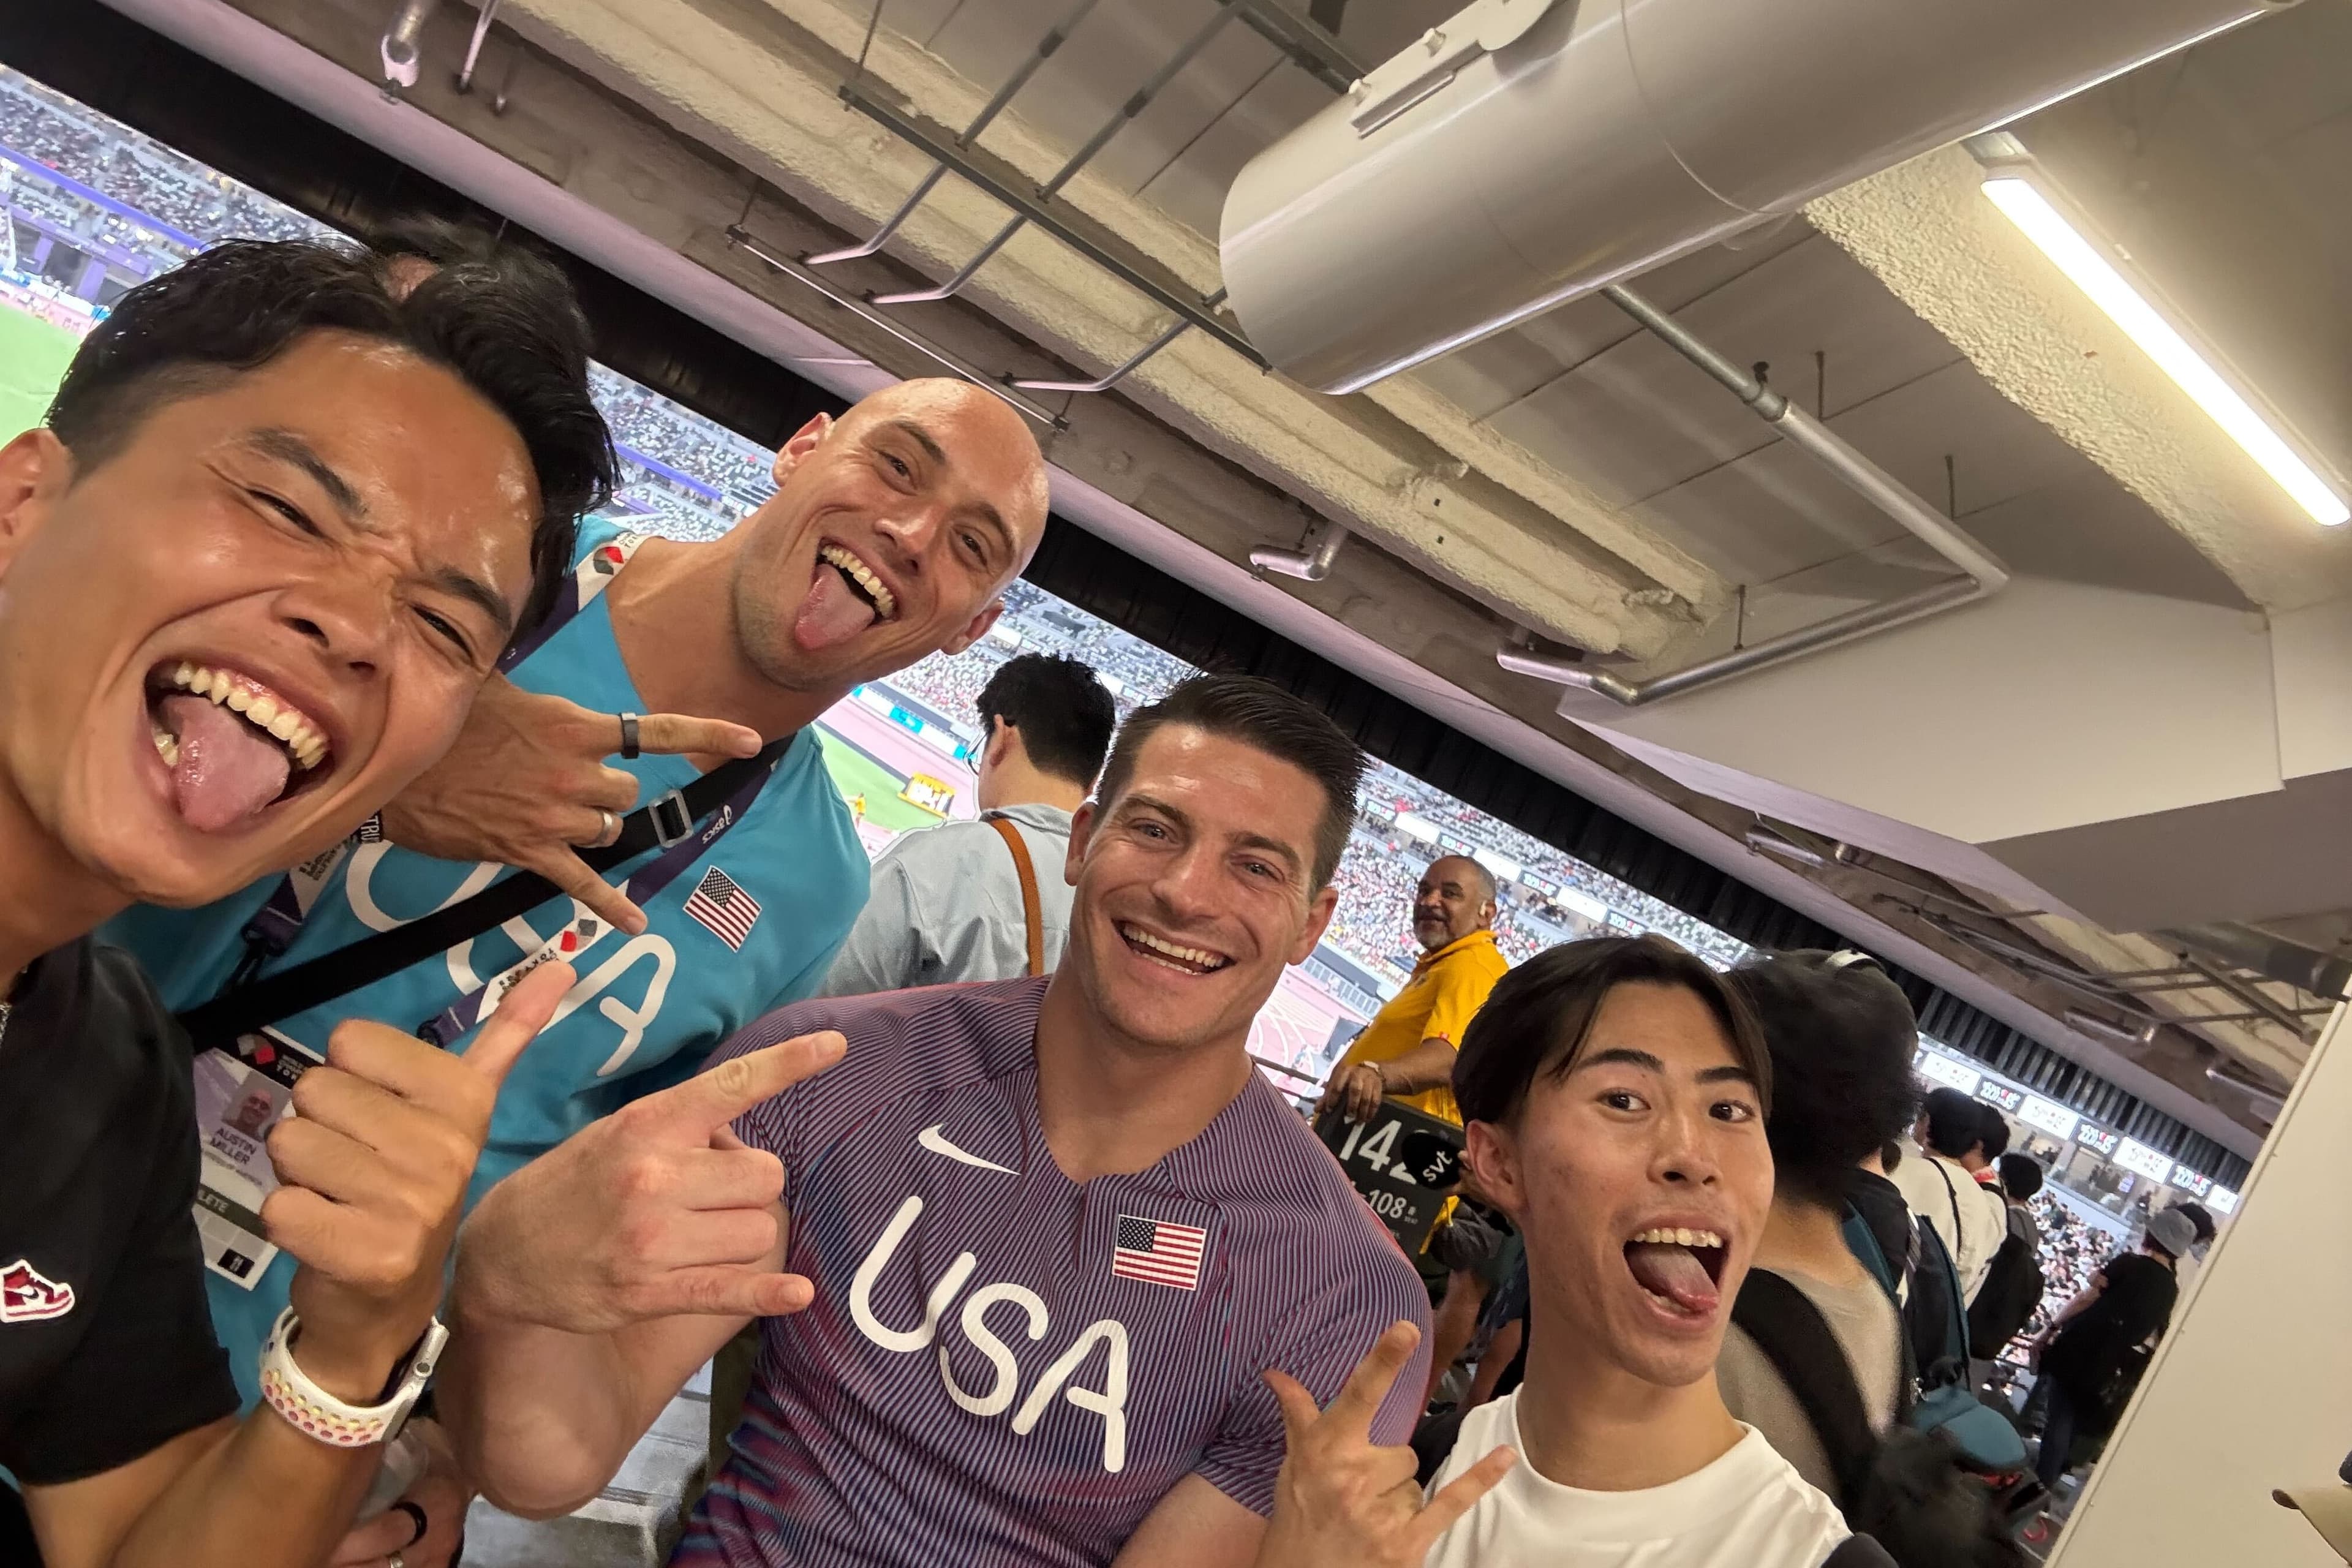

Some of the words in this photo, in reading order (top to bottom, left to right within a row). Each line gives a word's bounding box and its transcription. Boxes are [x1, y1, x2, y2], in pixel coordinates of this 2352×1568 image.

[210, 1137, 251, 1164] MILLER
[216, 1127, 257, 1155] AUSTIN
[1422, 1150, 1453, 1182] svt
[196, 1188, 230, 1214] LETE
[850, 1196, 1129, 1473] USA
